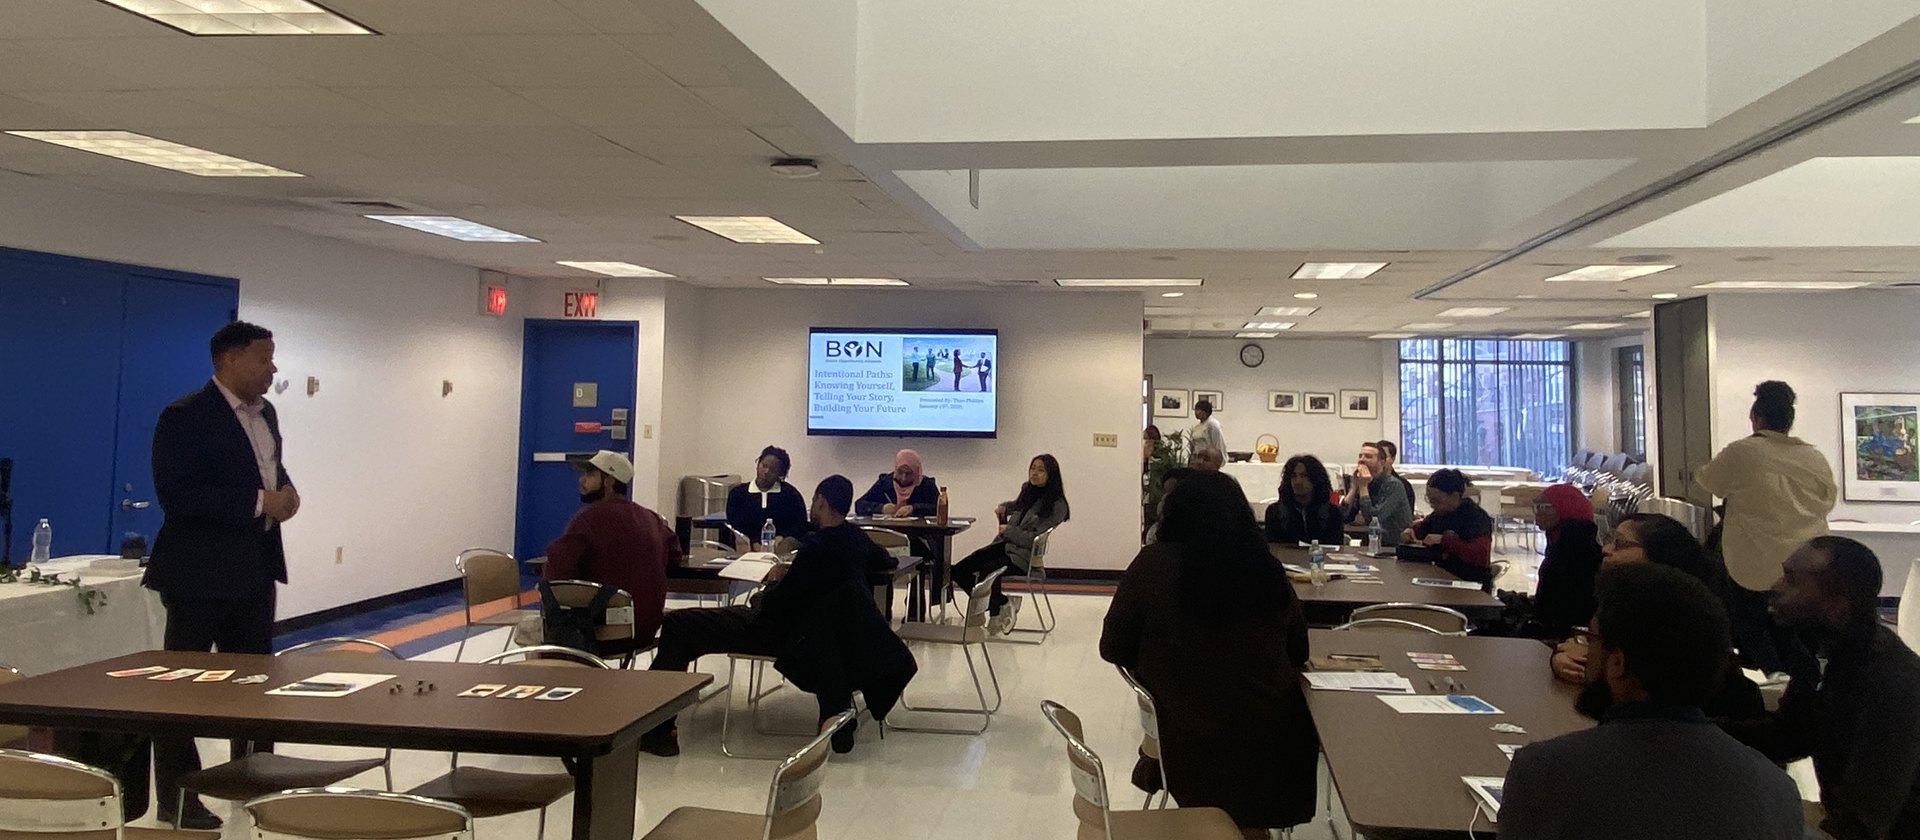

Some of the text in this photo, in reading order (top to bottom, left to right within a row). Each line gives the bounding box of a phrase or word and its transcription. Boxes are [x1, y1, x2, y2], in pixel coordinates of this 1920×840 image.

[564, 292, 599, 317] EXIT
[826, 340, 882, 358] BON
[814, 369, 893, 379] Intentional Paths:
[814, 381, 896, 391] Knowing Yourself,
[814, 392, 844, 402] Telling
[846, 393, 867, 401] Your
[814, 404, 907, 414] Building Your Future
